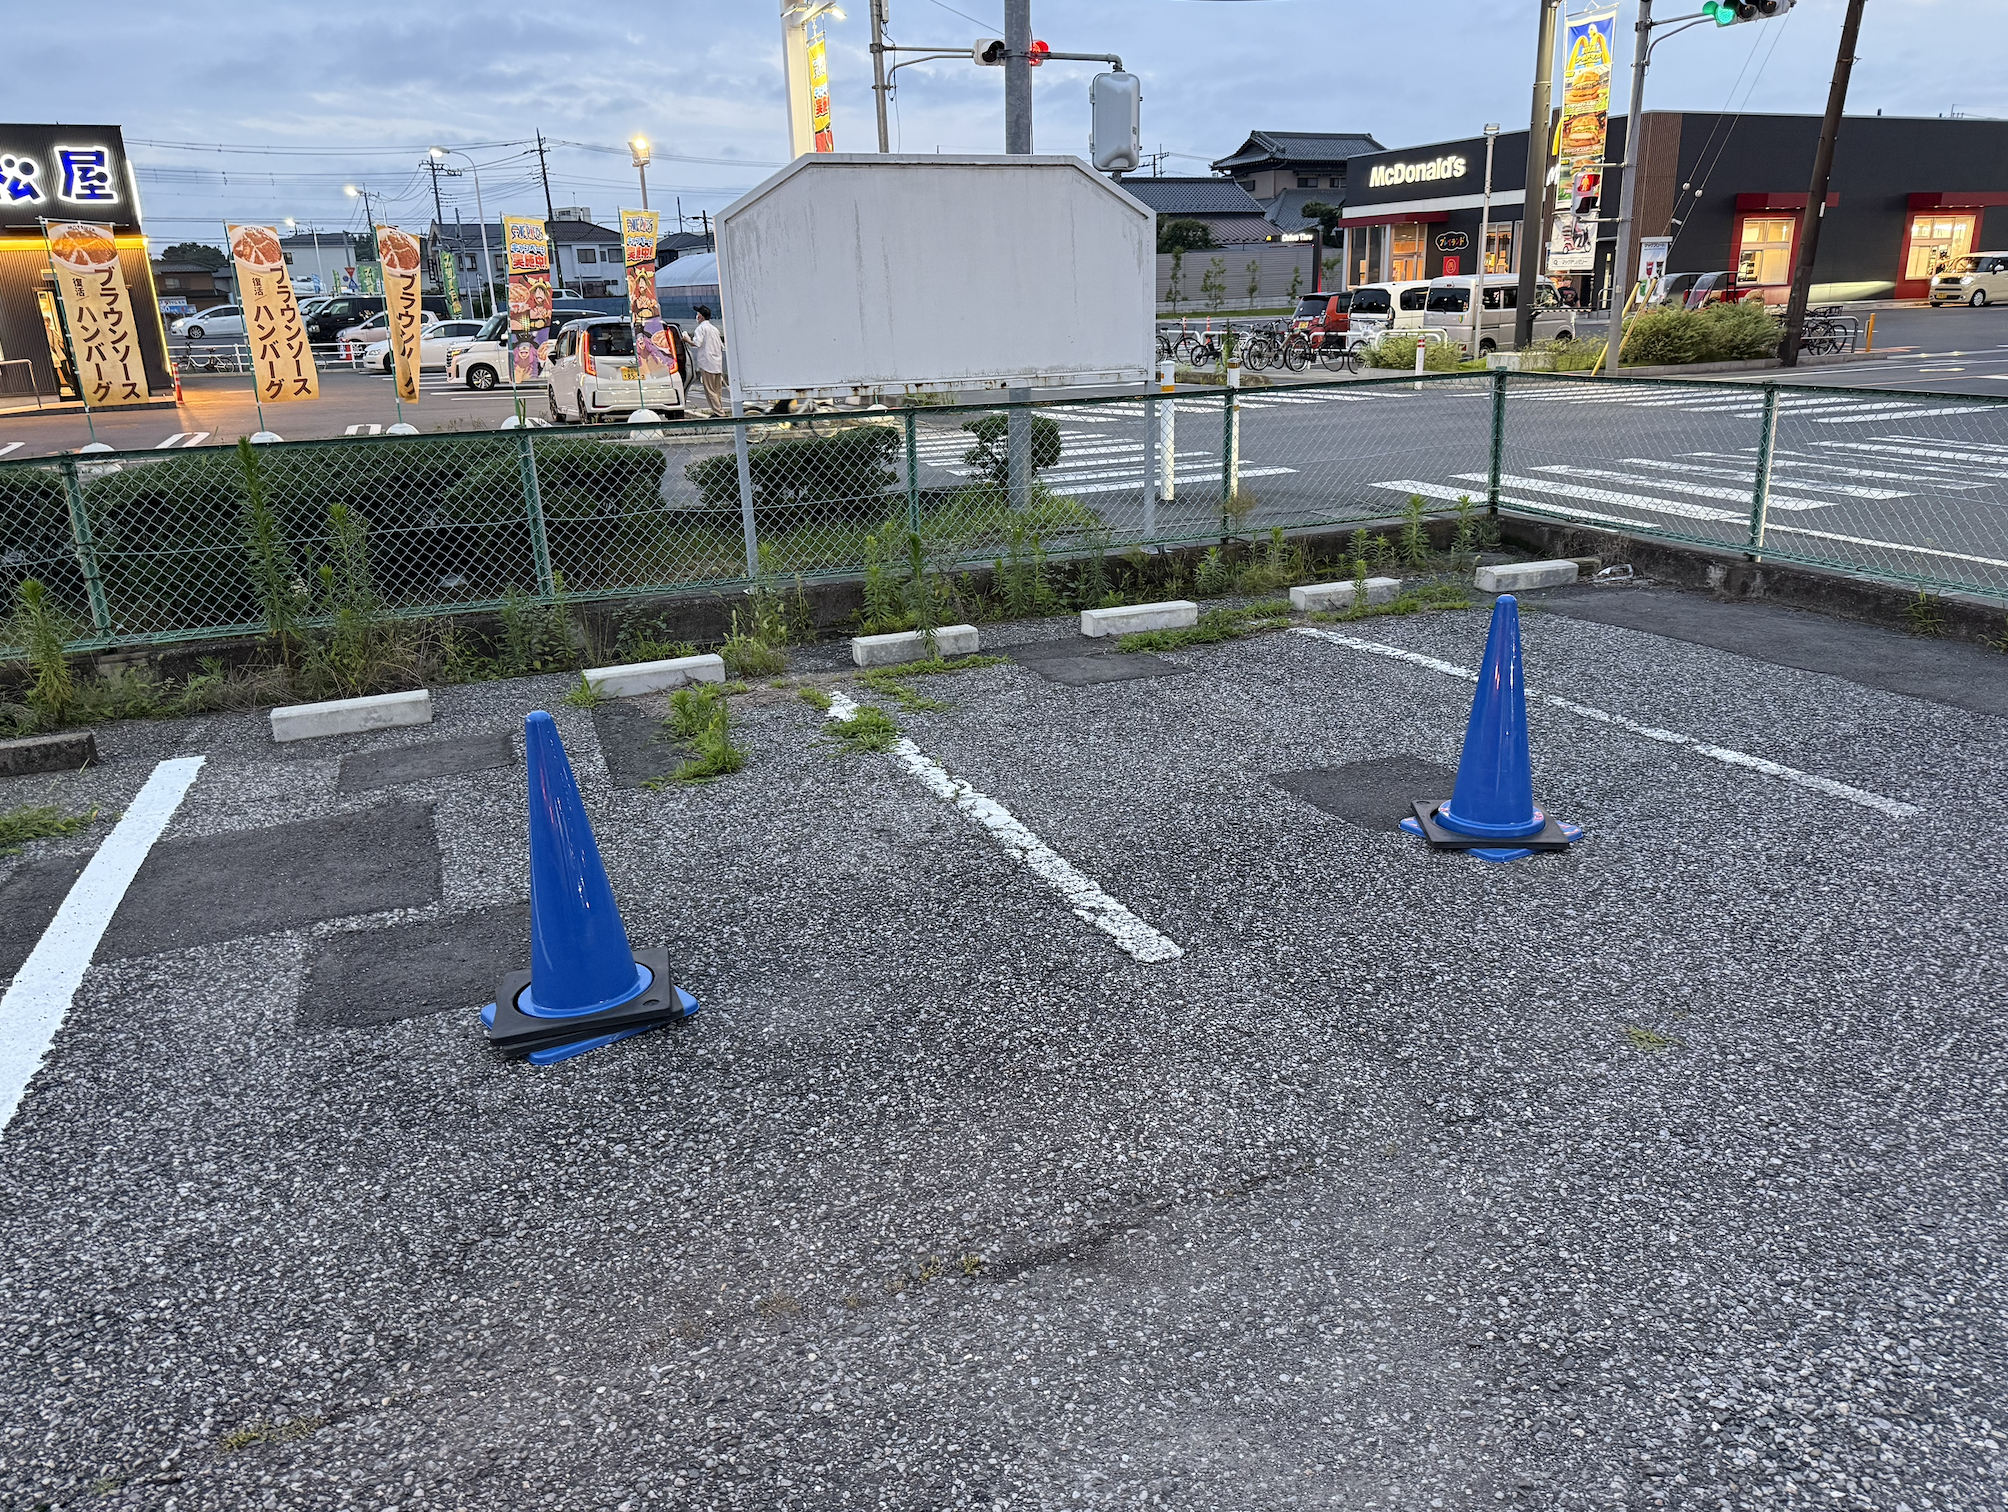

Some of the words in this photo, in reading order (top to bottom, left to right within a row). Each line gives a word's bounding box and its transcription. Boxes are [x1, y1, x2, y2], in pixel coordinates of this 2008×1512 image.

[1368, 155, 1467, 188] McDonald's
[1439, 236, 1466, 247] プレイランド
[73, 277, 86, 297] 復活
[252, 277, 264, 297] 復活
[76, 303, 113, 403] ハンバーグ
[94, 266, 141, 401] ブラウンソース
[253, 305, 285, 400] ハンバーグ
[269, 265, 312, 397] ブラウンソース
